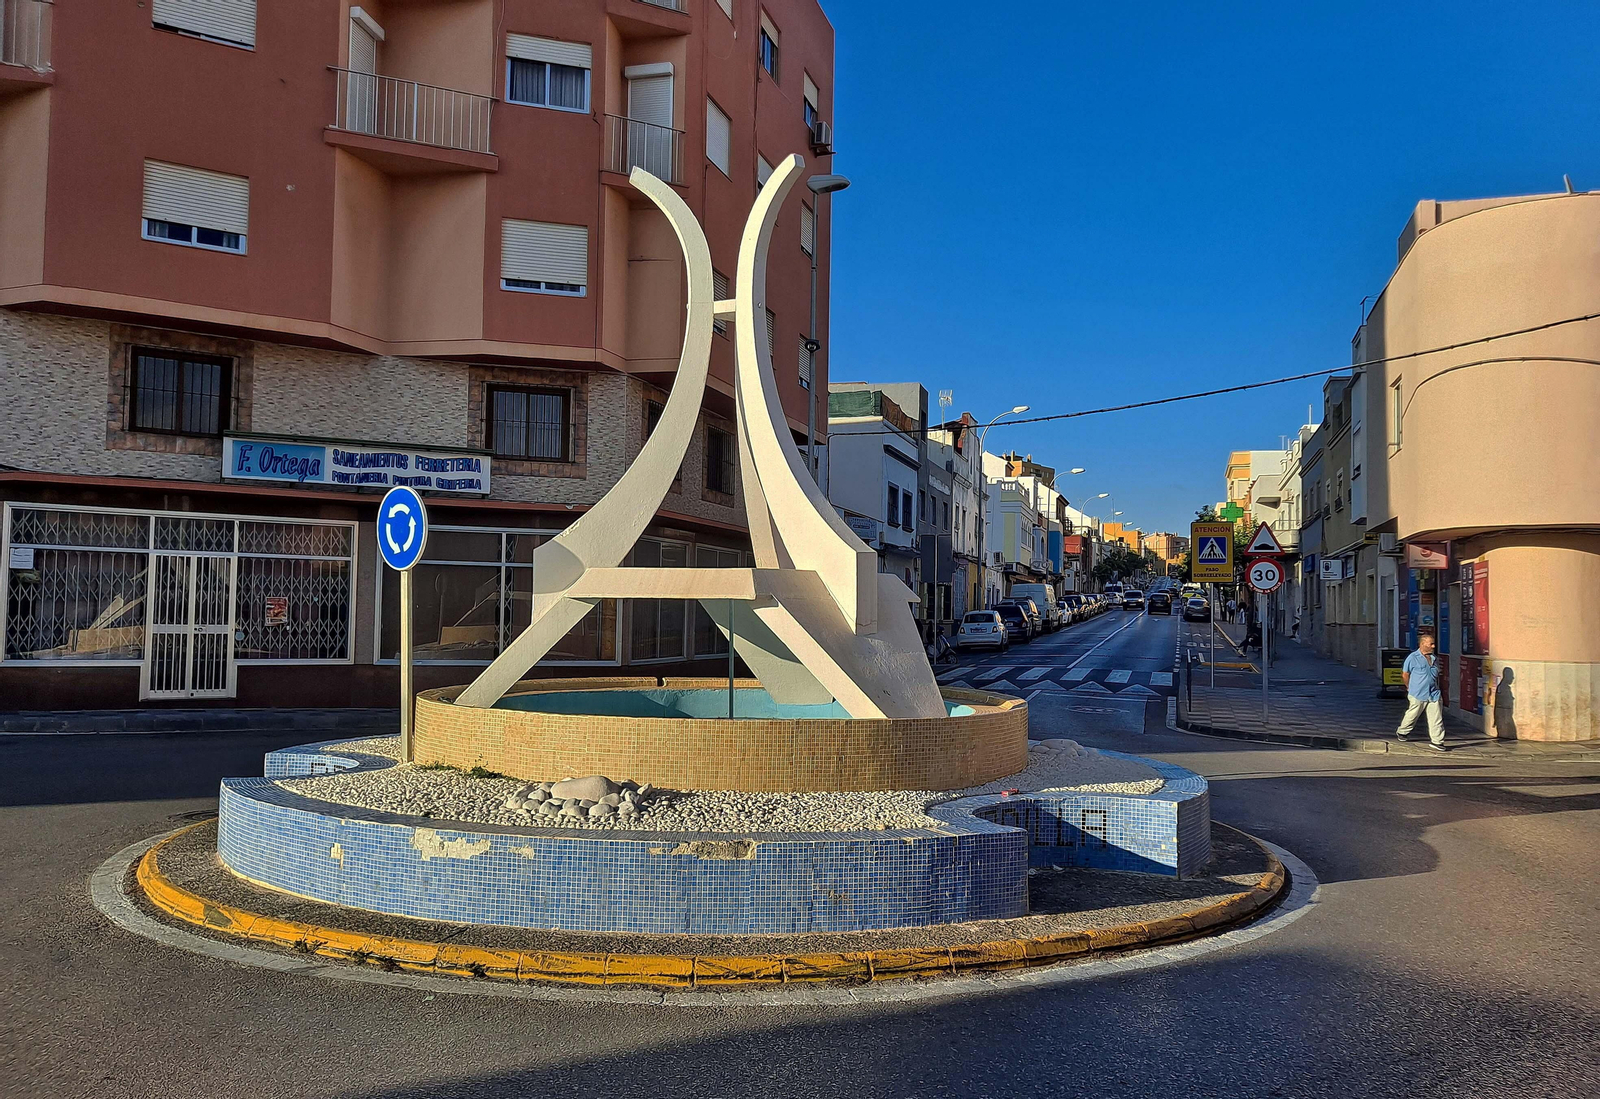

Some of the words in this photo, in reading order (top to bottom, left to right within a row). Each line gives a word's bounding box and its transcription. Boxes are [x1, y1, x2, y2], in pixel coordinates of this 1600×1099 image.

[237, 444, 253, 472] F.
[259, 446, 321, 482] Ortega
[332, 449, 409, 470] SANEAMIENTOS
[415, 455, 482, 473] FERRETERIA
[332, 470, 388, 484] FONTANERIA
[392, 475, 432, 487] PINTURA
[436, 477, 482, 490] GRIFERIA
[1253, 569, 1276, 581] 30
